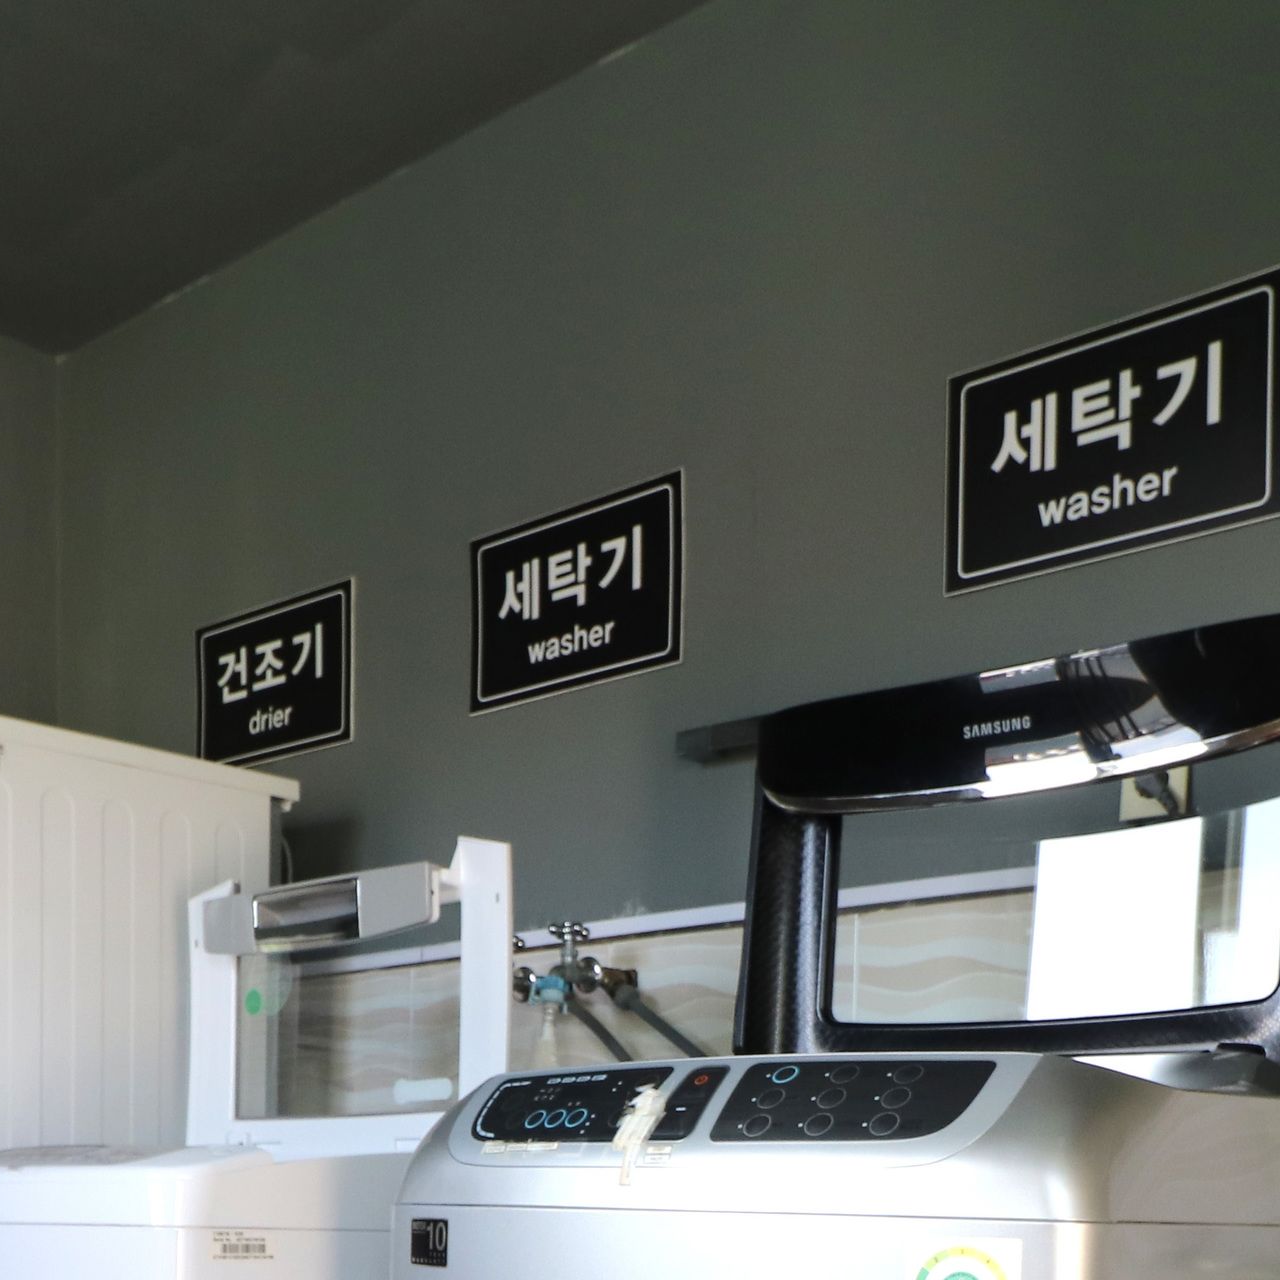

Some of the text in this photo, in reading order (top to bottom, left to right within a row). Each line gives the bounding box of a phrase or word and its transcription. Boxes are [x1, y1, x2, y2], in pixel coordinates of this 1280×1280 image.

[990, 340, 1223, 474] 세탁기
[1037, 464, 1180, 529] washer
[497, 523, 645, 623] 세탁기
[215, 622, 325, 705] 건조기
[527, 618, 616, 665] washer
[248, 703, 294, 737] drier
[962, 715, 1032, 740] SAMSUNG
[427, 1222, 446, 1251] 10
